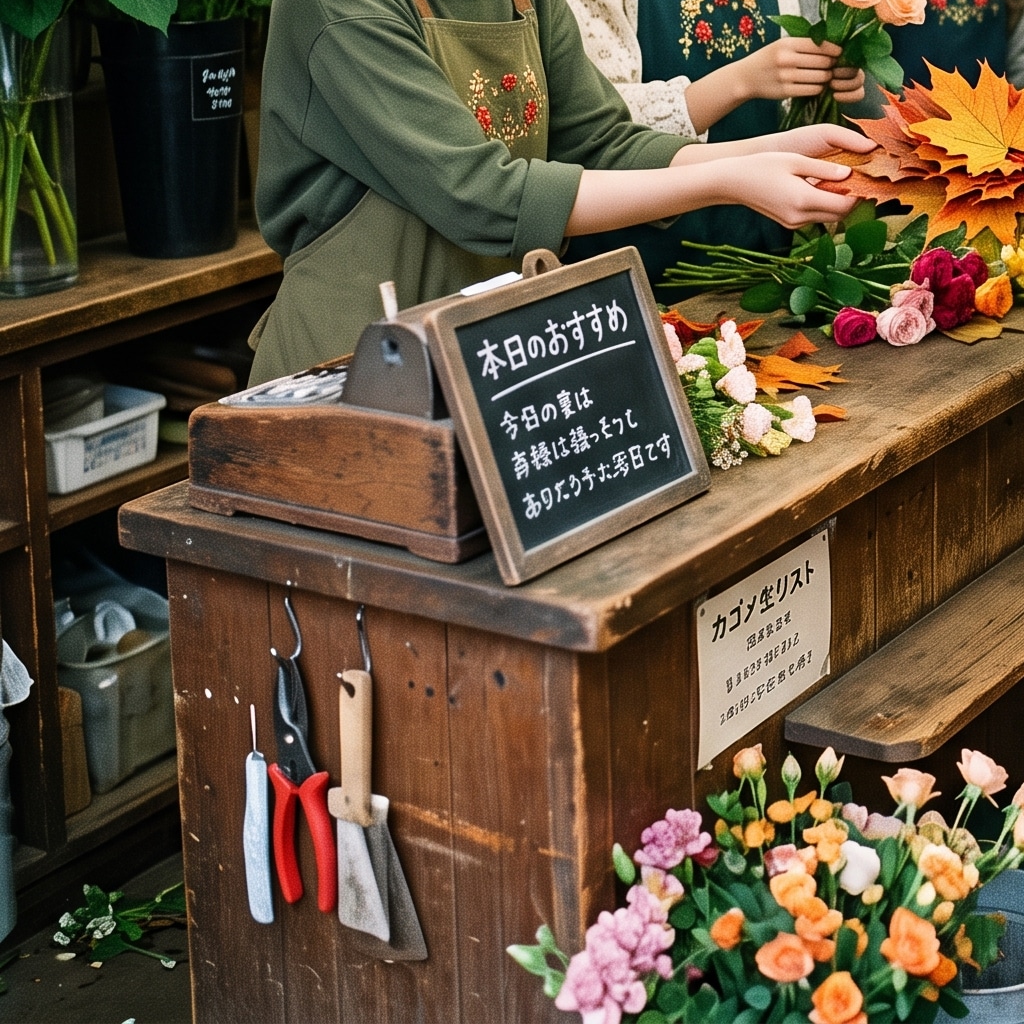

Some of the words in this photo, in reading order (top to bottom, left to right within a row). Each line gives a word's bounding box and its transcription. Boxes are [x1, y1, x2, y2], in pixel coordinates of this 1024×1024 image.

[475, 298, 629, 381] 本日のおすすめ
